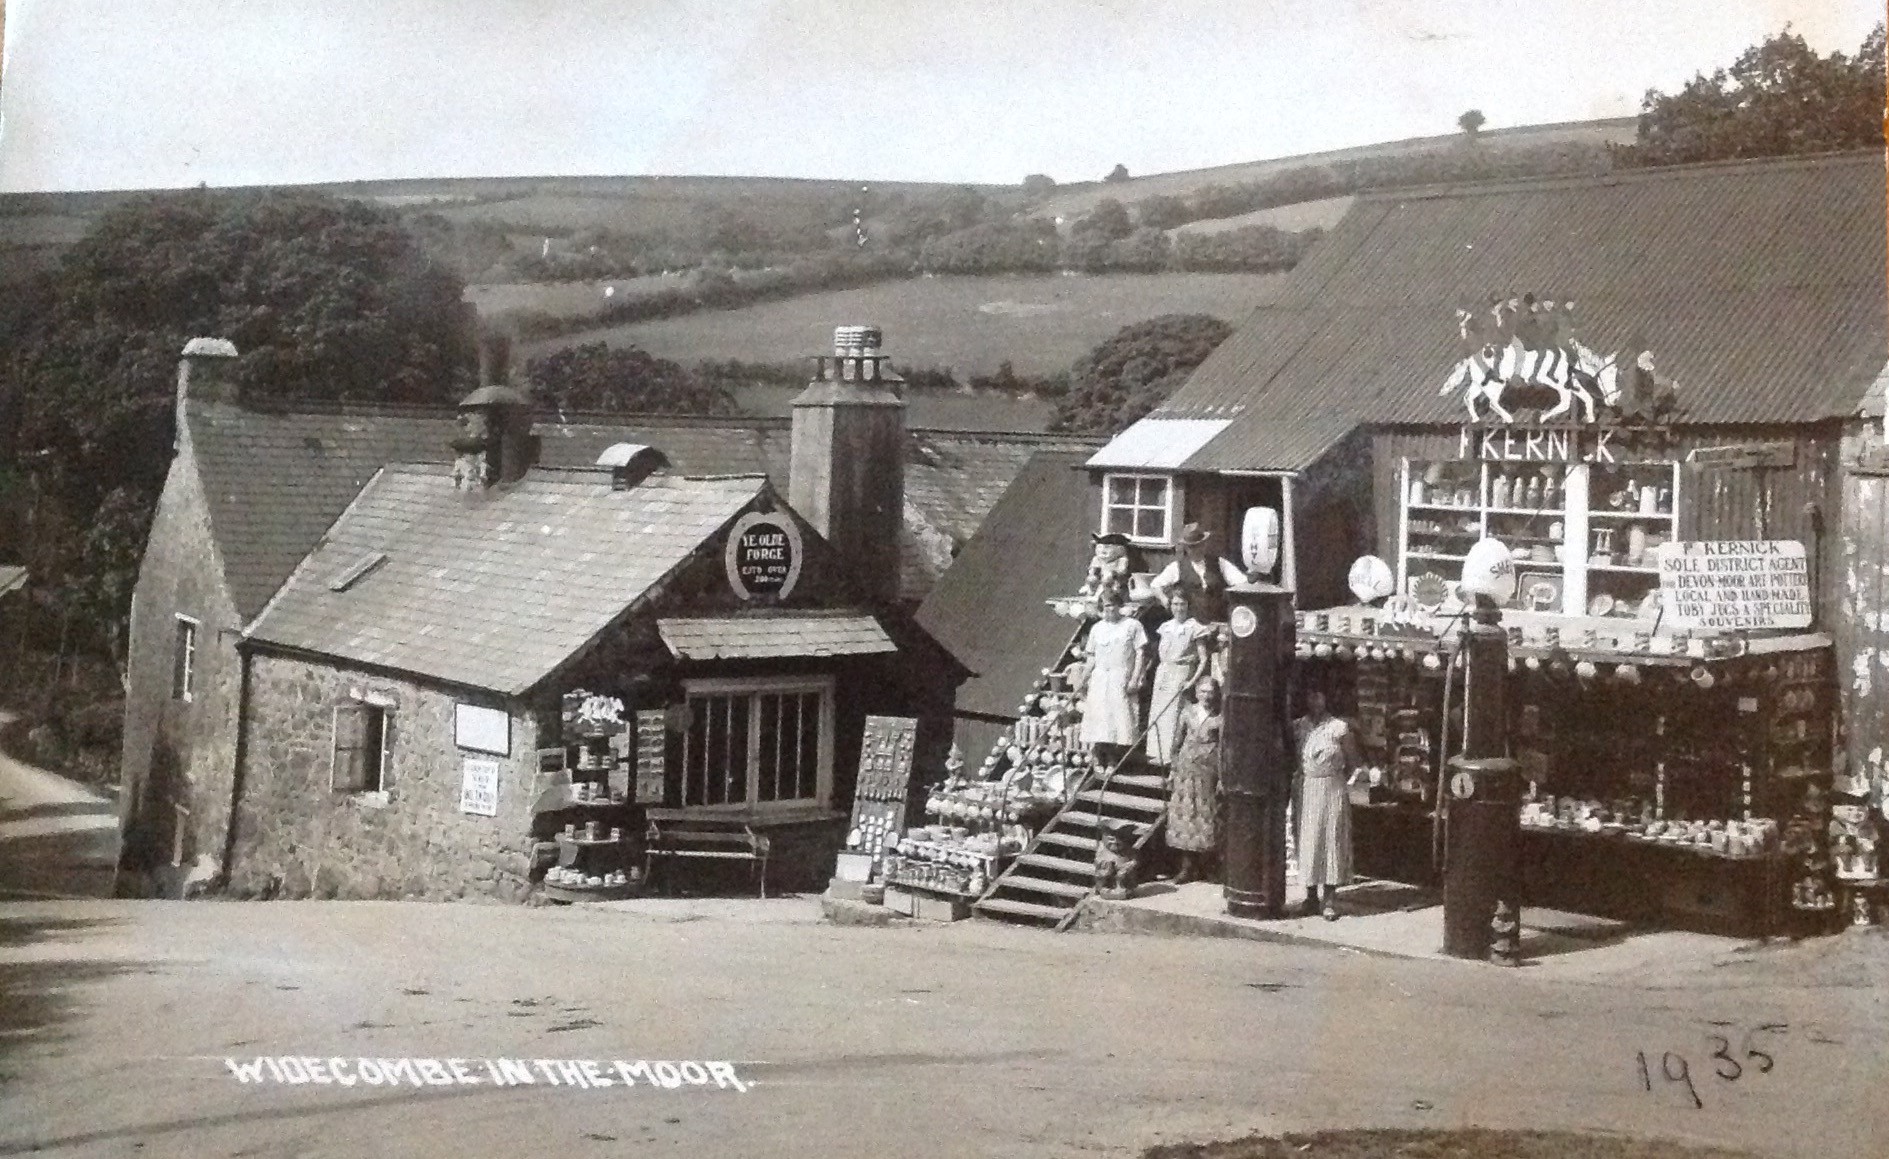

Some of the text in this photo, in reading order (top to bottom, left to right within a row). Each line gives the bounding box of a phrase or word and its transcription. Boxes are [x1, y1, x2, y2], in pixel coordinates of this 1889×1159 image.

[1481, 427, 1615, 463] KERNK
[742, 534, 757, 547] YE
[1704, 540, 1780, 555] KERNICK
[746, 547, 784, 561] FORGE
[1663, 557, 1700, 572] SOLE
[1707, 557, 1764, 572] DISTRICT
[1678, 574, 1715, 589] DEVON
[1749, 573, 1766, 588] ART
[1675, 590, 1712, 602] LOCAL
[1716, 590, 1739, 602] AND
[1741, 589, 1769, 602] HAND
[1676, 603, 1704, 617] TOBY
[1711, 603, 1739, 616] JUGS
[1699, 616, 1775, 629] SOUVENIRS
[1637, 1024, 1788, 1110] 1935
